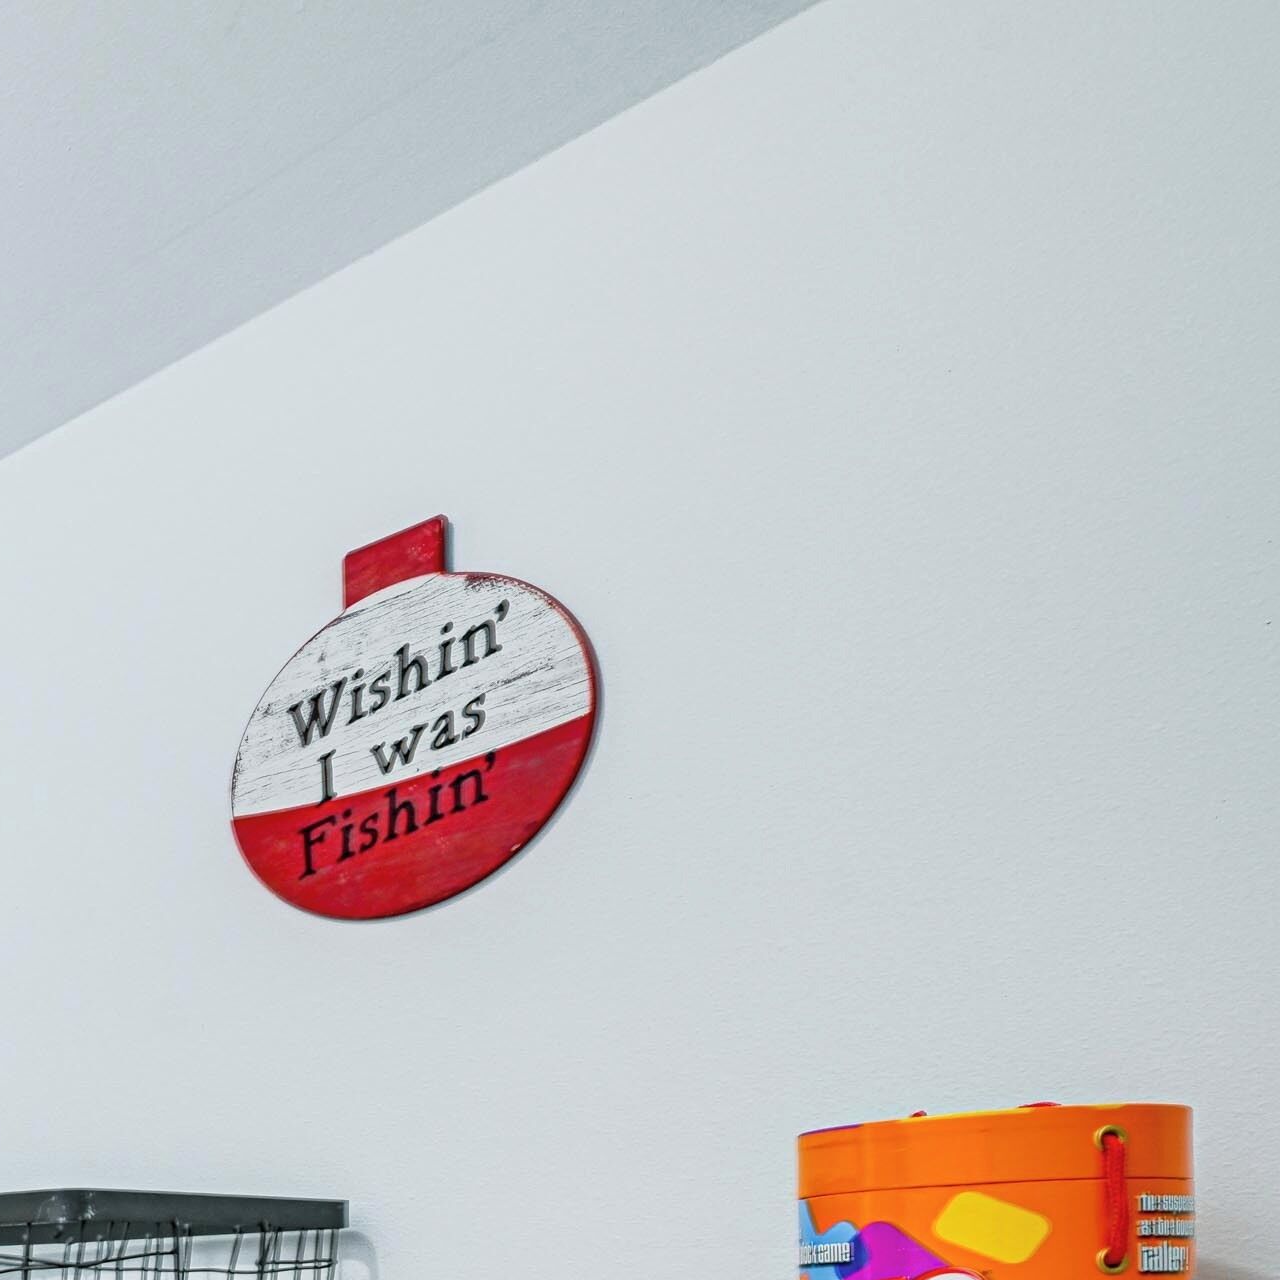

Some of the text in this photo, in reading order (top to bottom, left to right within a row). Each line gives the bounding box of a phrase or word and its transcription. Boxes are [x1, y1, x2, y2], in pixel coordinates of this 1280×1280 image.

[287, 600, 510, 748] Wishin'
[298, 748, 497, 880] Fishin'
[317, 693, 489, 805] I was
